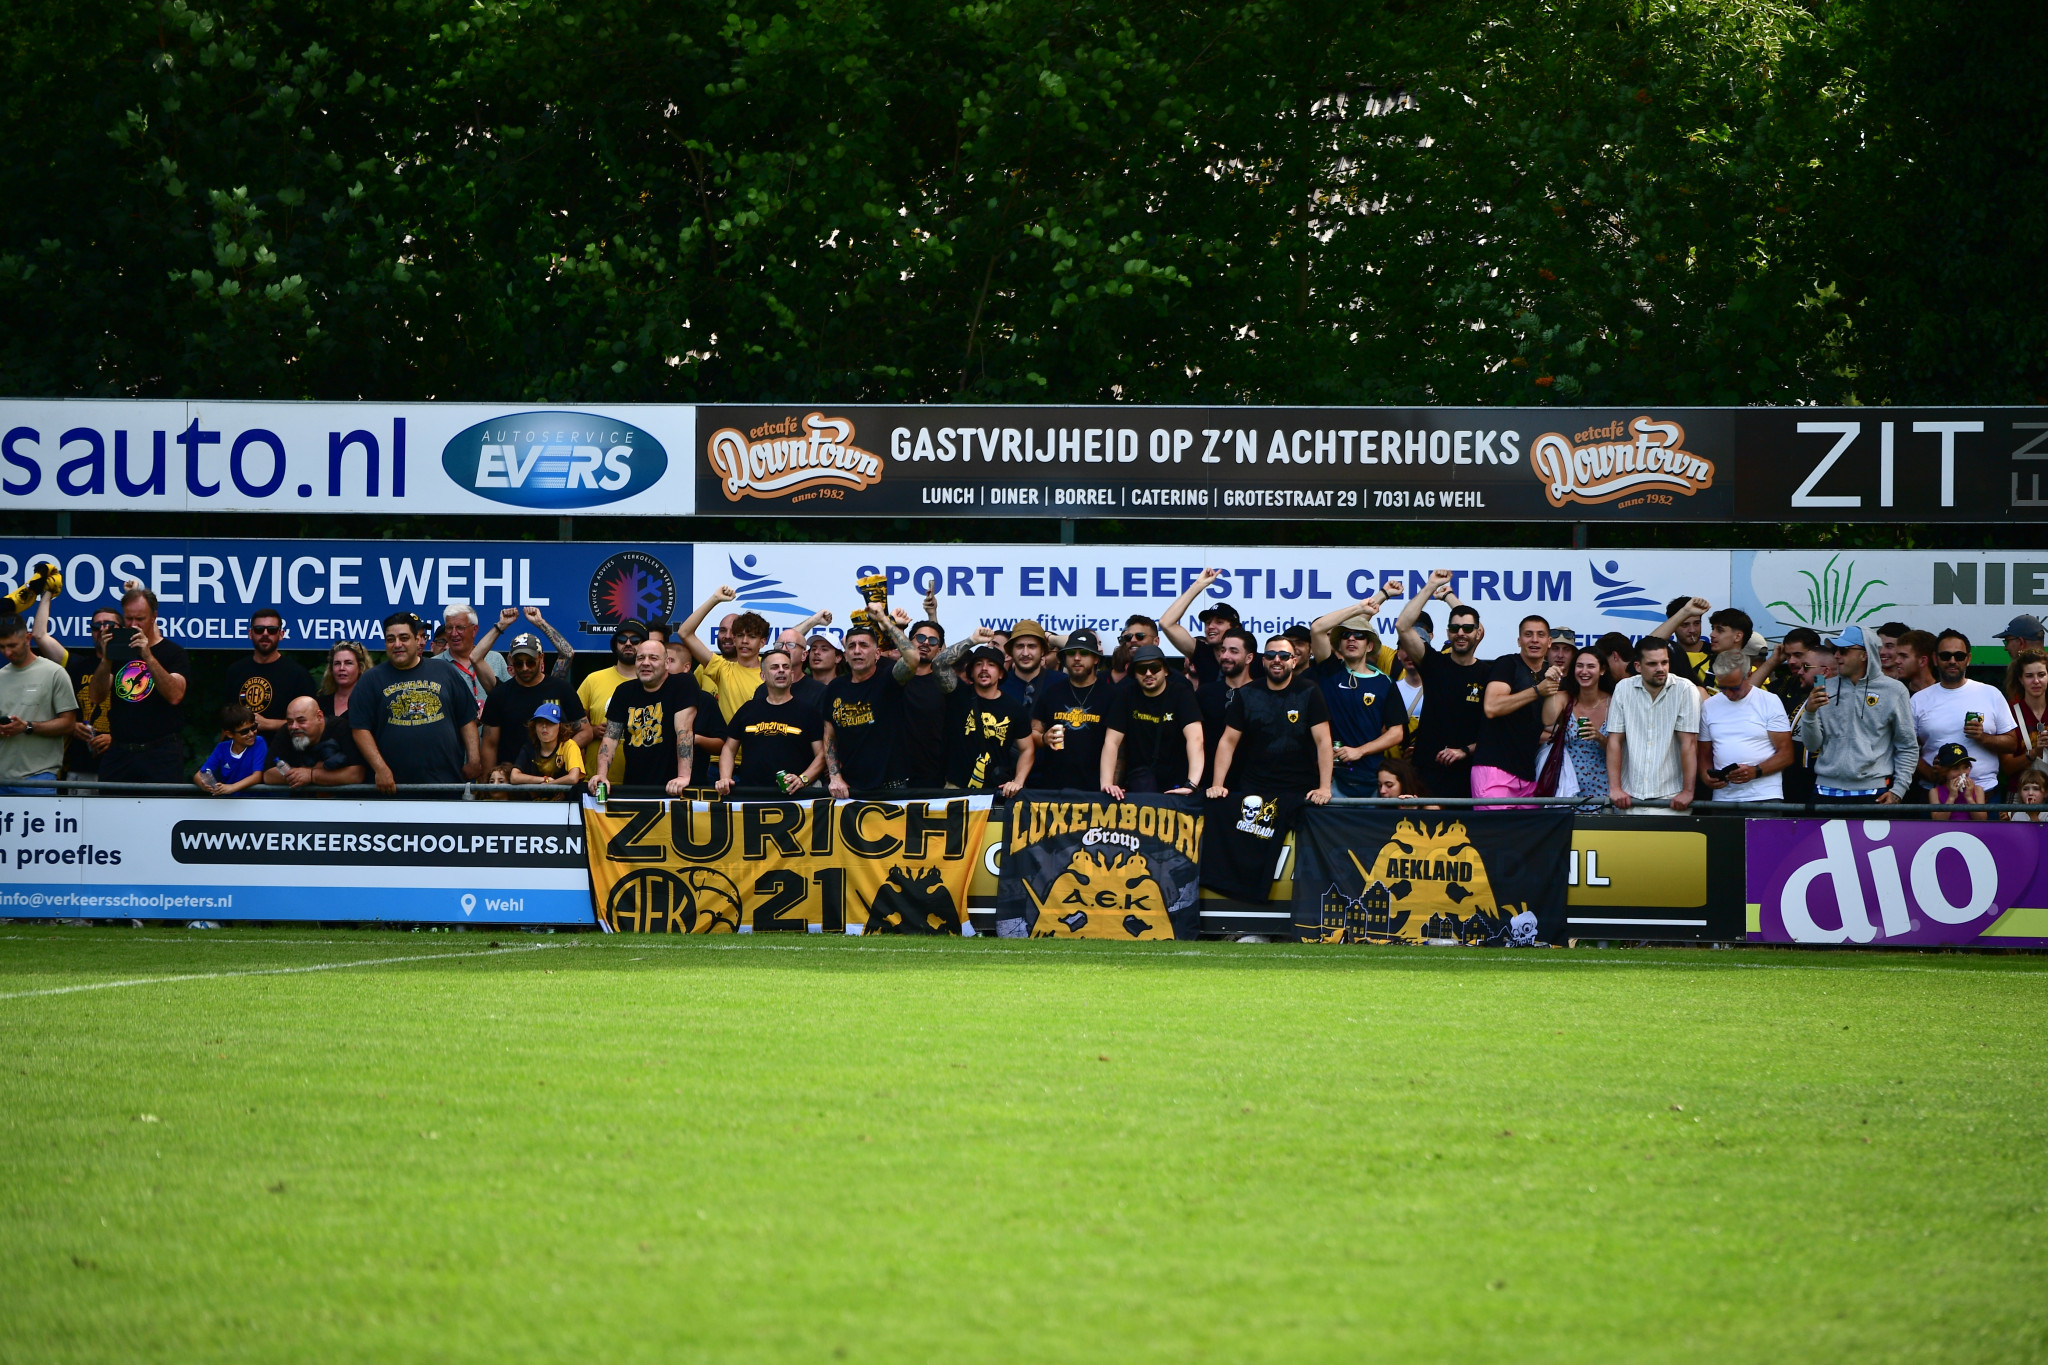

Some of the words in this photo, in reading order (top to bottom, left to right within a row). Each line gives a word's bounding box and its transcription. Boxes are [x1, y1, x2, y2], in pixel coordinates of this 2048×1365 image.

[481, 430, 634, 444] AUTOSERVICE
[749, 416, 798, 439] eetcafé
[1574, 420, 1624, 443] eetcafé
[1, 417, 406, 498] sauto.nl
[713, 414, 879, 494] Downtown
[890, 427, 1138, 463] GASTVRIJHEID
[1150, 428, 1193, 464] OP
[1266, 429, 1520, 466] ACHTERHOEKS
[1536, 419, 1709, 498] Downtown
[1791, 421, 1985, 507] ZIT
[792, 491, 817, 504] anno
[818, 487, 845, 501] 1982
[922, 486, 975, 505] LUNCH
[990, 487, 1039, 505] DINER
[1055, 487, 1116, 506] BORREL
[1131, 488, 1209, 507] CATERING
[1223, 489, 1334, 507] GROTESTRAAT
[1337, 489, 1357, 508] 29
[1373, 490, 1410, 508] 7031
[1413, 490, 1436, 508] AG
[1439, 491, 1485, 508] WEHL
[1617, 498, 1644, 510] anno
[1645, 493, 1674, 507] 1982
[380, 556, 550, 606] WEHL
[1020, 566, 1077, 598] EN
[1096, 566, 1332, 601] LEEFSTIJL
[1346, 568, 1572, 602] CENTRUM
[21, 811, 45, 838] je
[55, 811, 78, 833] in
[605, 788, 970, 863] ZÜRICH
[180, 832, 585, 855] WWW.VERKEERSSCHOOLPETERS.N
[1082, 828, 1140, 852] Group
[17, 845, 122, 869] proefles
[1386, 858, 1473, 882] AEKLAND
[1780, 819, 1998, 943] dio
[485, 898, 524, 911] Wehl
[753, 867, 846, 932] 21
